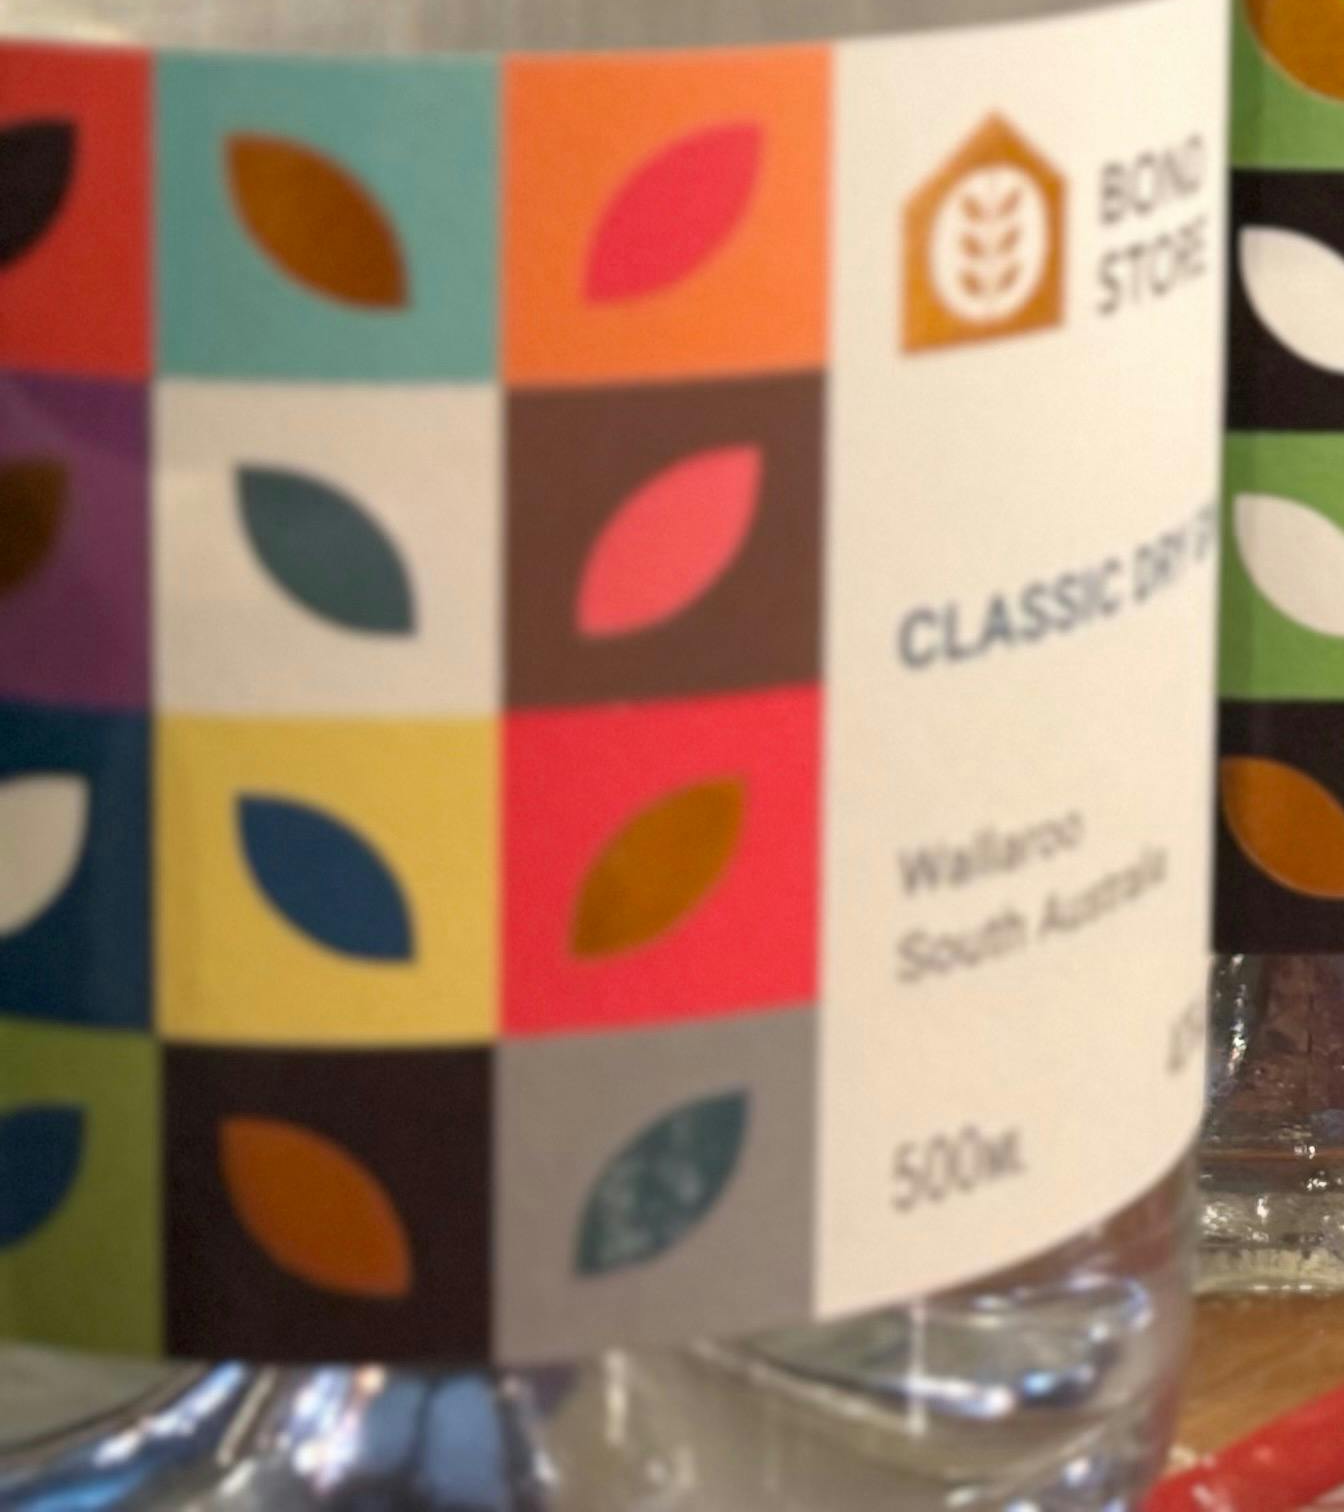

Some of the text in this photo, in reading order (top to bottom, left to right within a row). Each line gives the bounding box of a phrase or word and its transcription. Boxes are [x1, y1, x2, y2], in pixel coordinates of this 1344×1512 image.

[896, 556, 1124, 672] CLASSIC
[897, 810, 1083, 895] Wallaroo
[896, 907, 1027, 985] South
